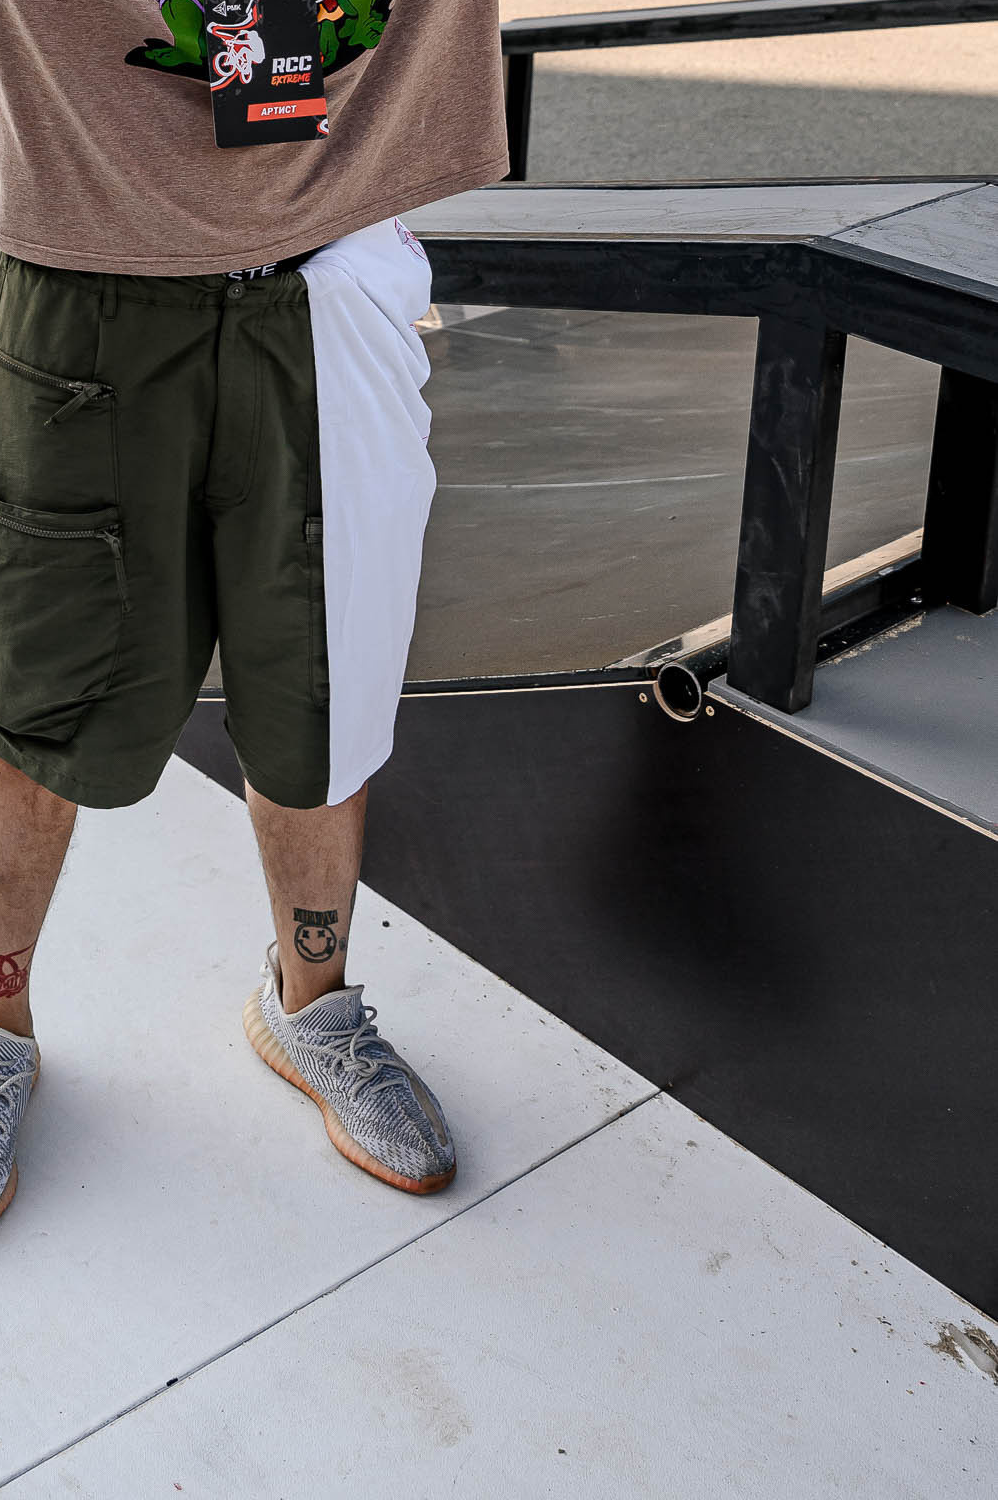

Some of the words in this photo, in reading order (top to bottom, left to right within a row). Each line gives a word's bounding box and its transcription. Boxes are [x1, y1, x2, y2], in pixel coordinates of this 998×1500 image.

[272, 55, 312, 74] RCC
[271, 72, 312, 87] EXTREME
[261, 104, 297, 116] АРТИСТ
